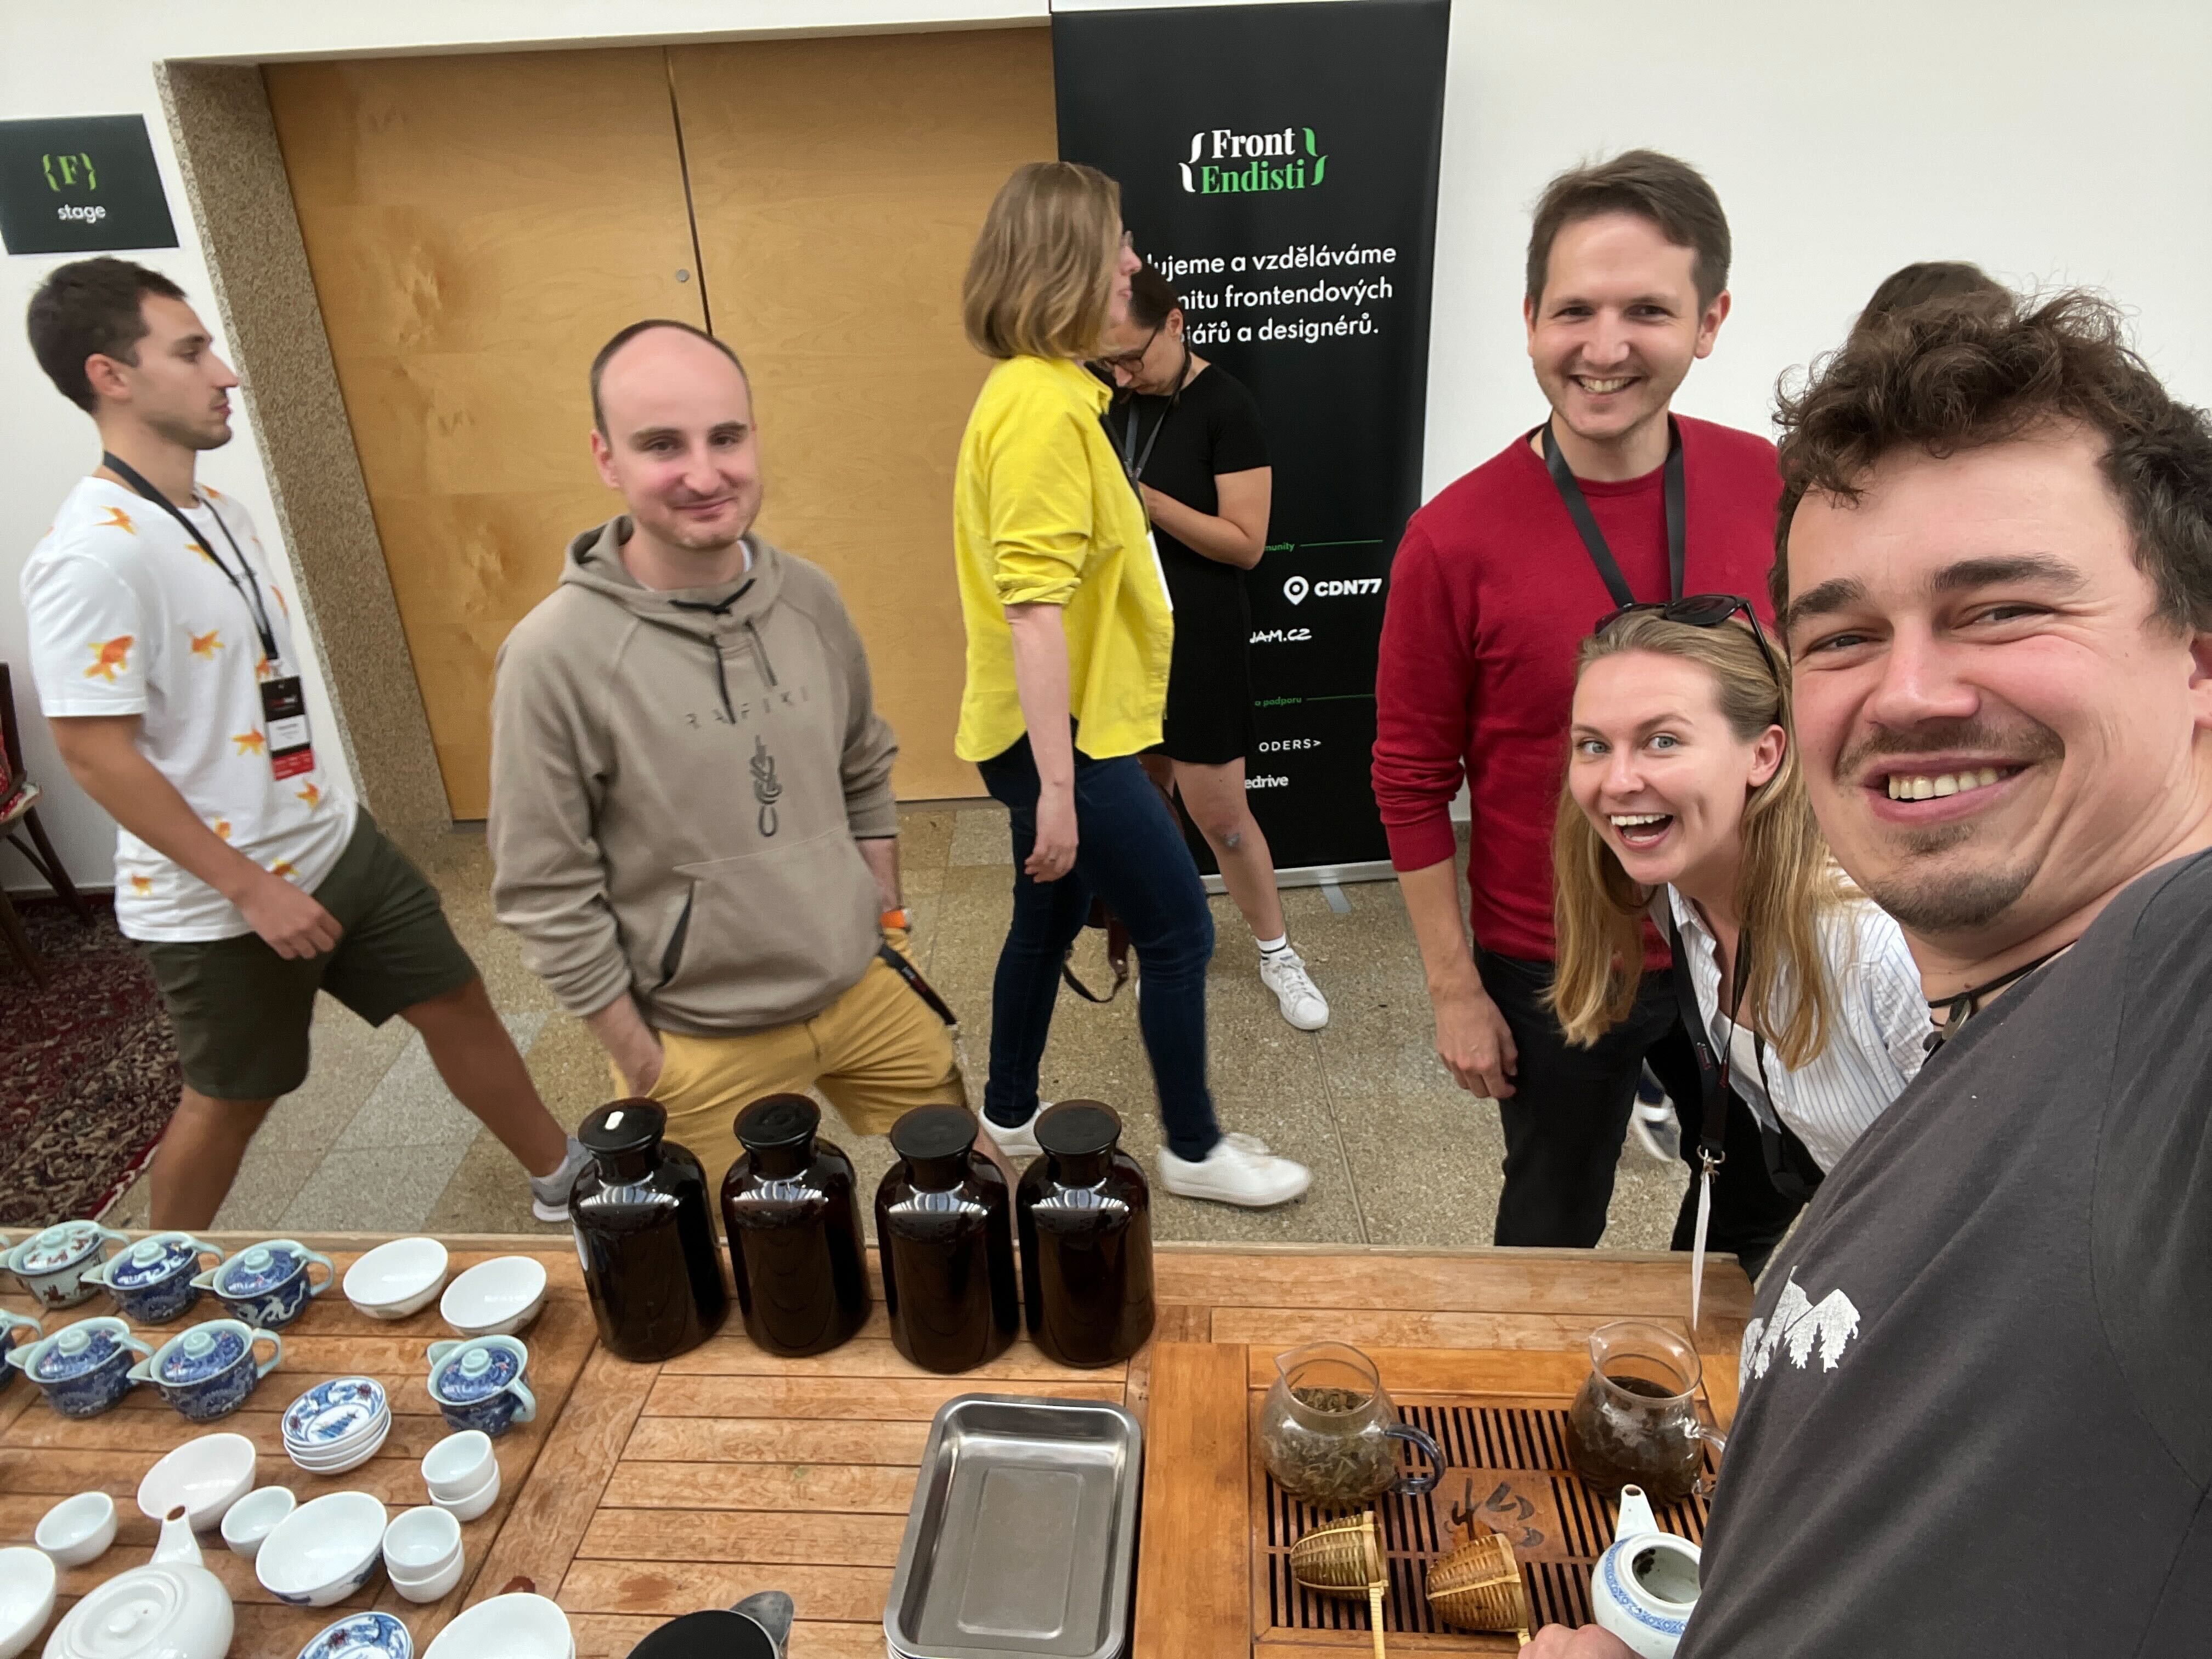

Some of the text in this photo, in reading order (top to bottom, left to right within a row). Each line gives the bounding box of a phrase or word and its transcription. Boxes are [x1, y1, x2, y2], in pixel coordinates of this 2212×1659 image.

[1211, 127, 1296, 159] Front
[1201, 159, 1305, 194] Endisti
[57, 204, 106, 224] stage
[1231, 256, 1246, 272] a
[1252, 243, 1396, 270] vzděláváme
[1177, 276, 1392, 311] nitu frontendových
[1237, 327, 1251, 342] a
[1258, 312, 1379, 344] designérů.
[1314, 578, 1383, 597] CDN77
[1245, 774, 1289, 789] edrive
